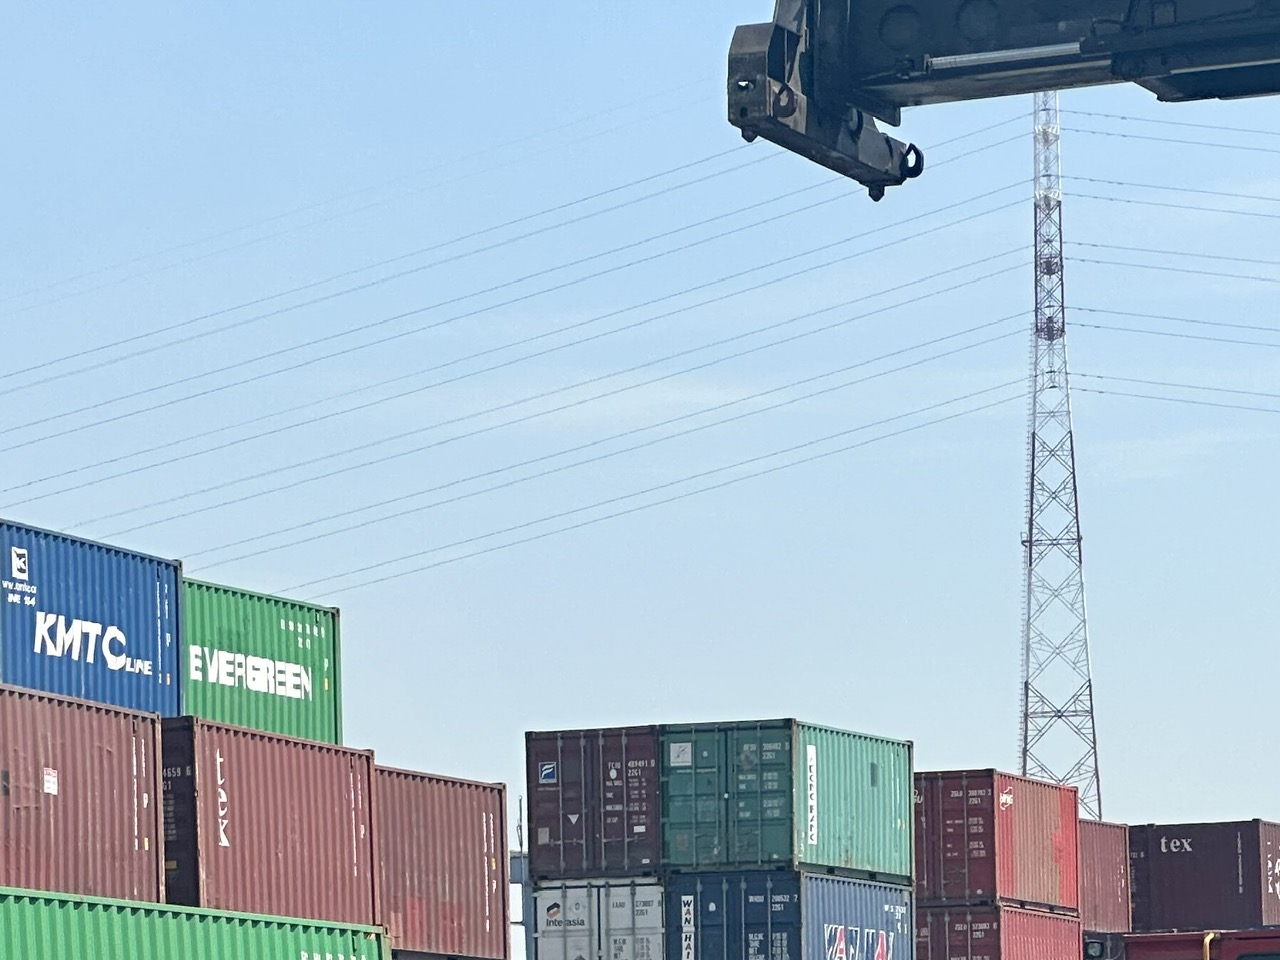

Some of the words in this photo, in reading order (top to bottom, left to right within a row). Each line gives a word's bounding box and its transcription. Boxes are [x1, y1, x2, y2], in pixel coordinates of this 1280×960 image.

[33, 611, 127, 671] KMTC
[125, 657, 153, 676] LINE
[189, 644, 313, 701] EVERGREEN
[216, 748, 230, 847] tex
[1160, 835, 1193, 852] tex
[546, 917, 585, 927] Interasia
[682, 899, 693, 925] WAN
[684, 934, 693, 960] HAI
